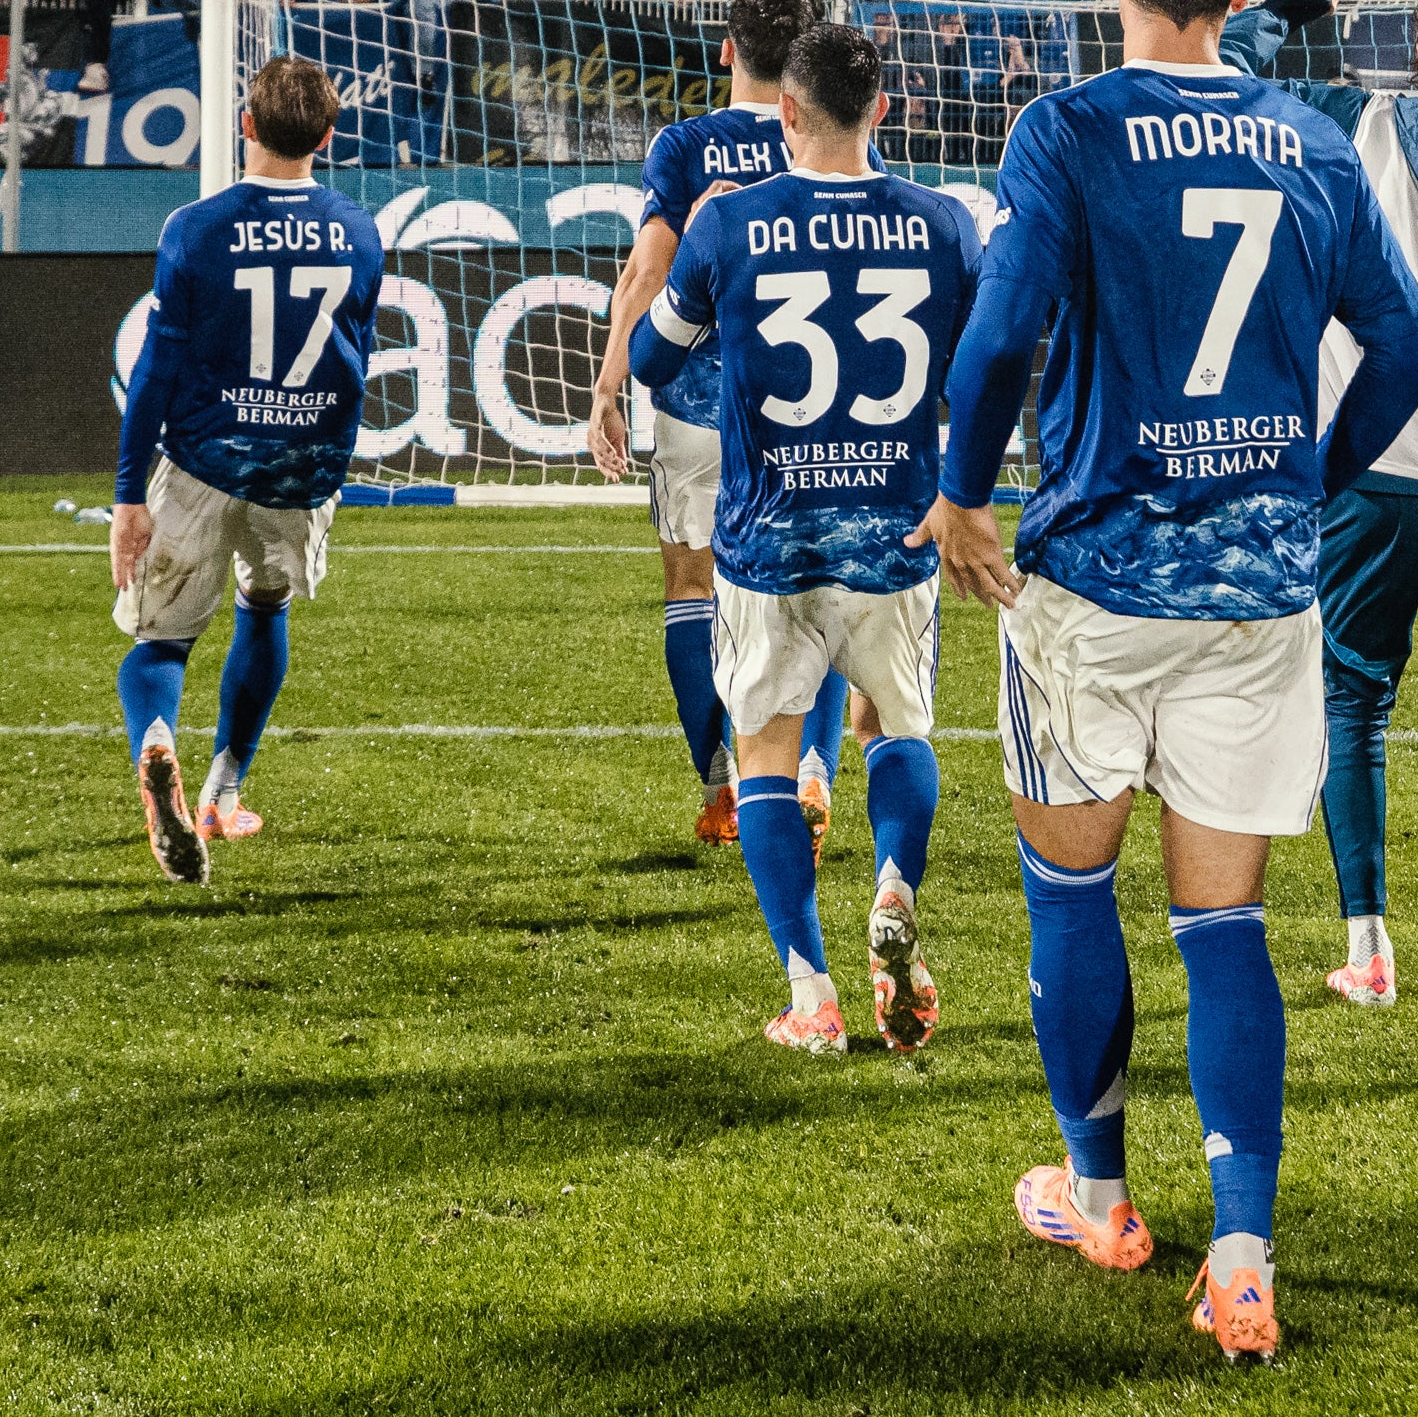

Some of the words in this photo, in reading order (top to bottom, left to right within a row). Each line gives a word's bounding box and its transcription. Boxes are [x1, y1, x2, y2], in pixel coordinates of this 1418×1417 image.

[703, 137, 772, 175] ÁLEX
[1124, 112, 1303, 168] MORATA
[229, 213, 321, 253] JESÙS
[328, 221, 353, 252] R.
[747, 215, 796, 256] DA
[808, 213, 930, 251] CUNHA
[1181, 187, 1284, 397] 7
[233, 265, 353, 388] 17
[755, 268, 931, 427] 33
[221, 386, 338, 407] NEUBERGER
[236, 406, 320, 426] BERMAN
[1137, 415, 1306, 447] NEUBERGER
[762, 440, 910, 468] NEUBERGER
[1165, 448, 1281, 480] BERMAN
[783, 467, 888, 491] BERMAN
